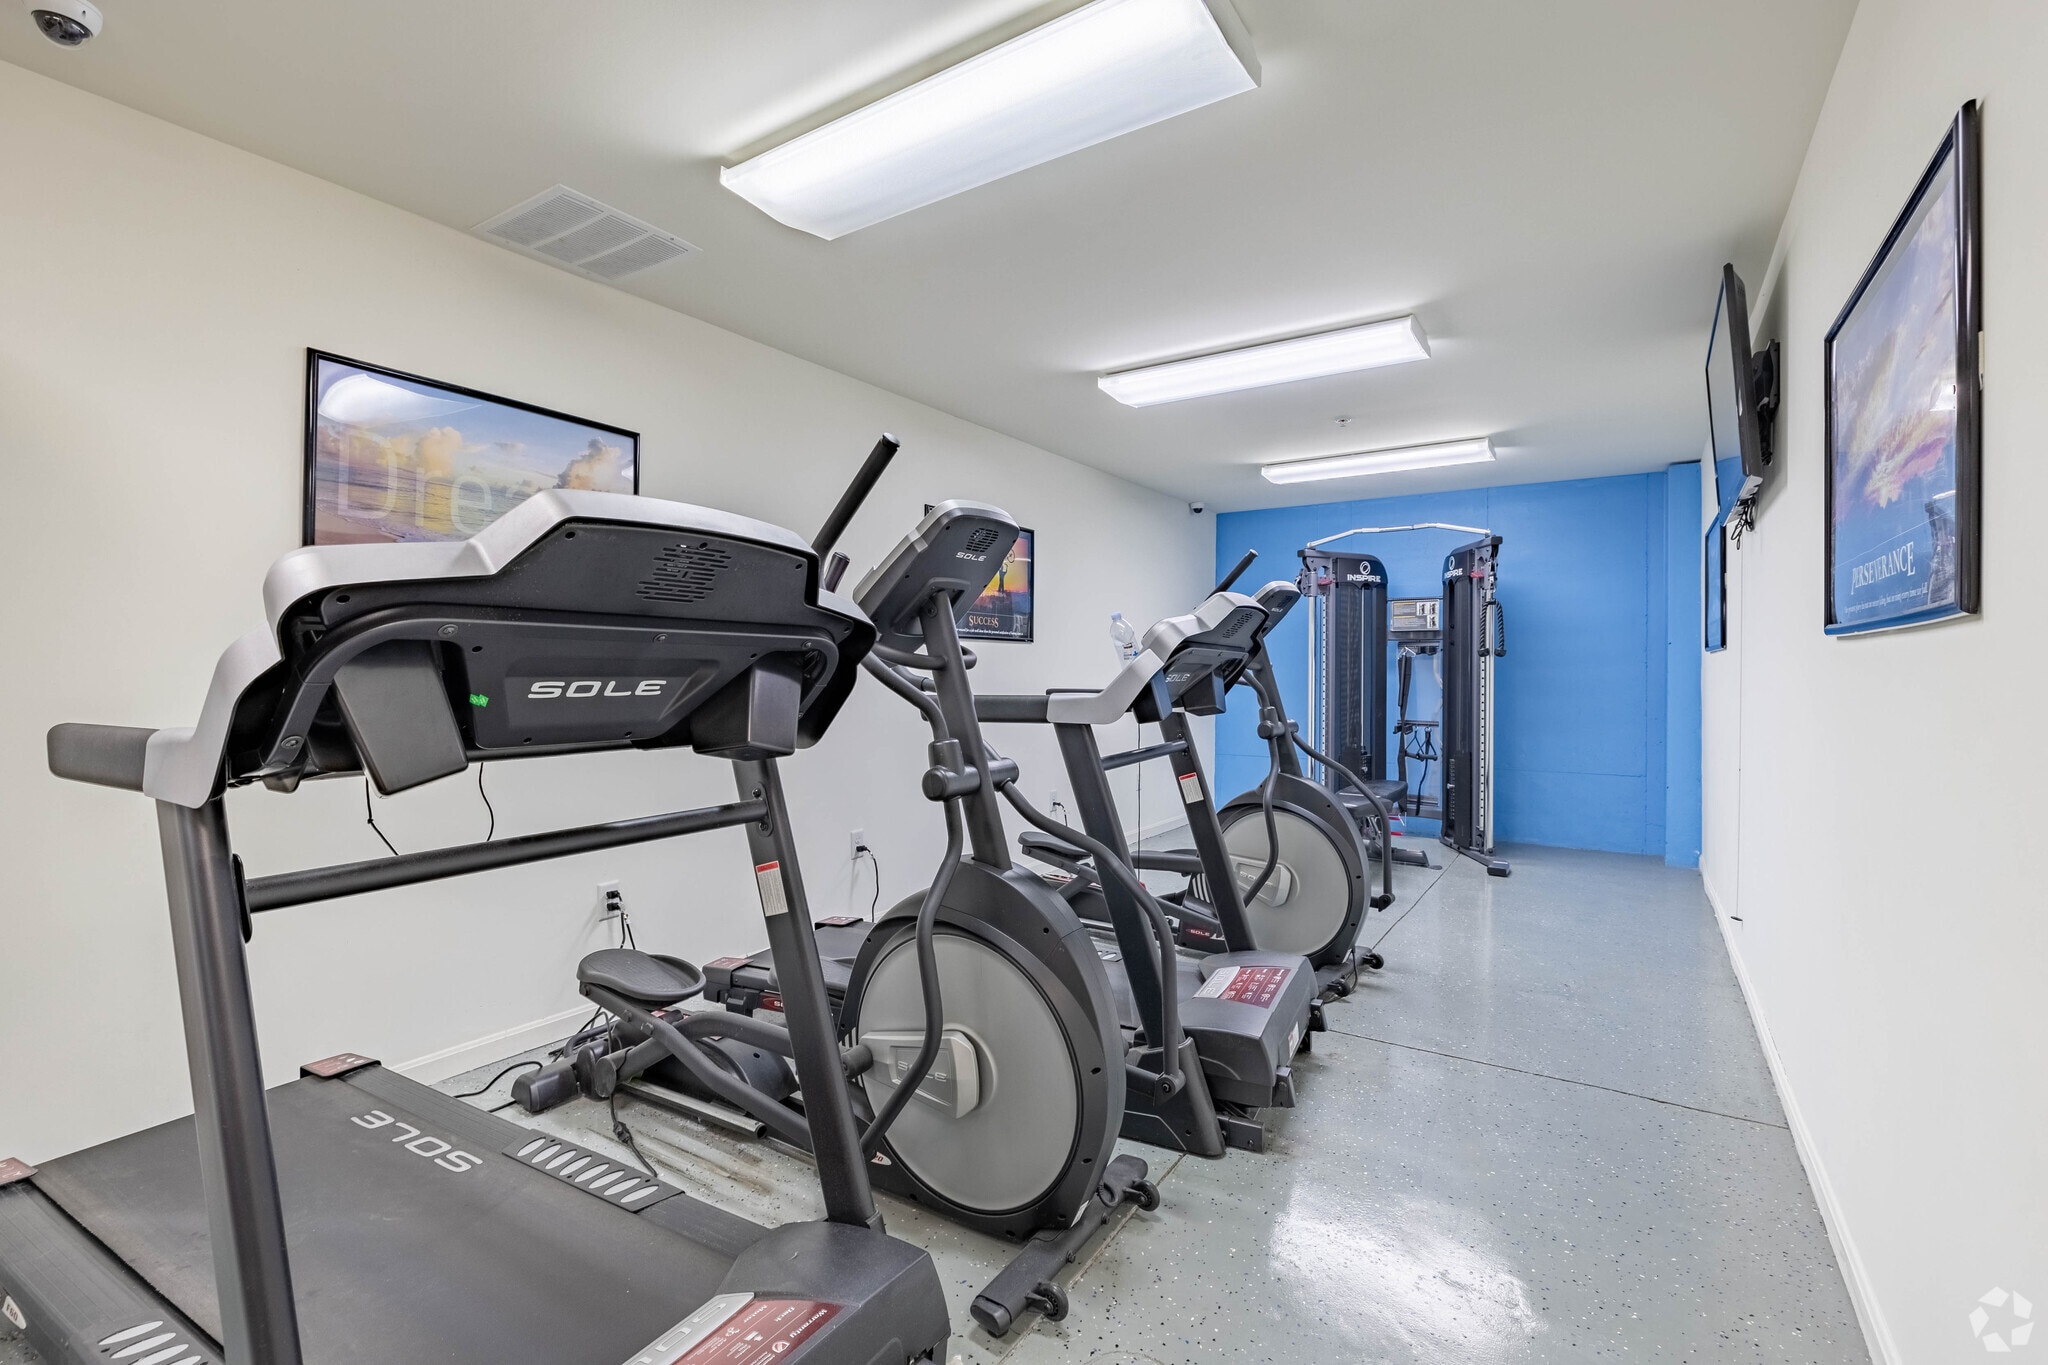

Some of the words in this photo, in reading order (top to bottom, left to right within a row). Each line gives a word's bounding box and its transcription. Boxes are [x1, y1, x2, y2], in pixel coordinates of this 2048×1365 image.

[954, 551, 987, 562] SOLE
[1850, 540, 1916, 596] PERSEVERANCE
[1346, 573, 1382, 583] INSPIRE
[968, 614, 999, 629] SUCCESS
[1165, 673, 1191, 683] SOLE
[527, 680, 667, 699] SOLE
[1189, 928, 1211, 937] SOLE
[350, 1109, 484, 1174] SOLE
[788, 1308, 828, 1339] Warranty
